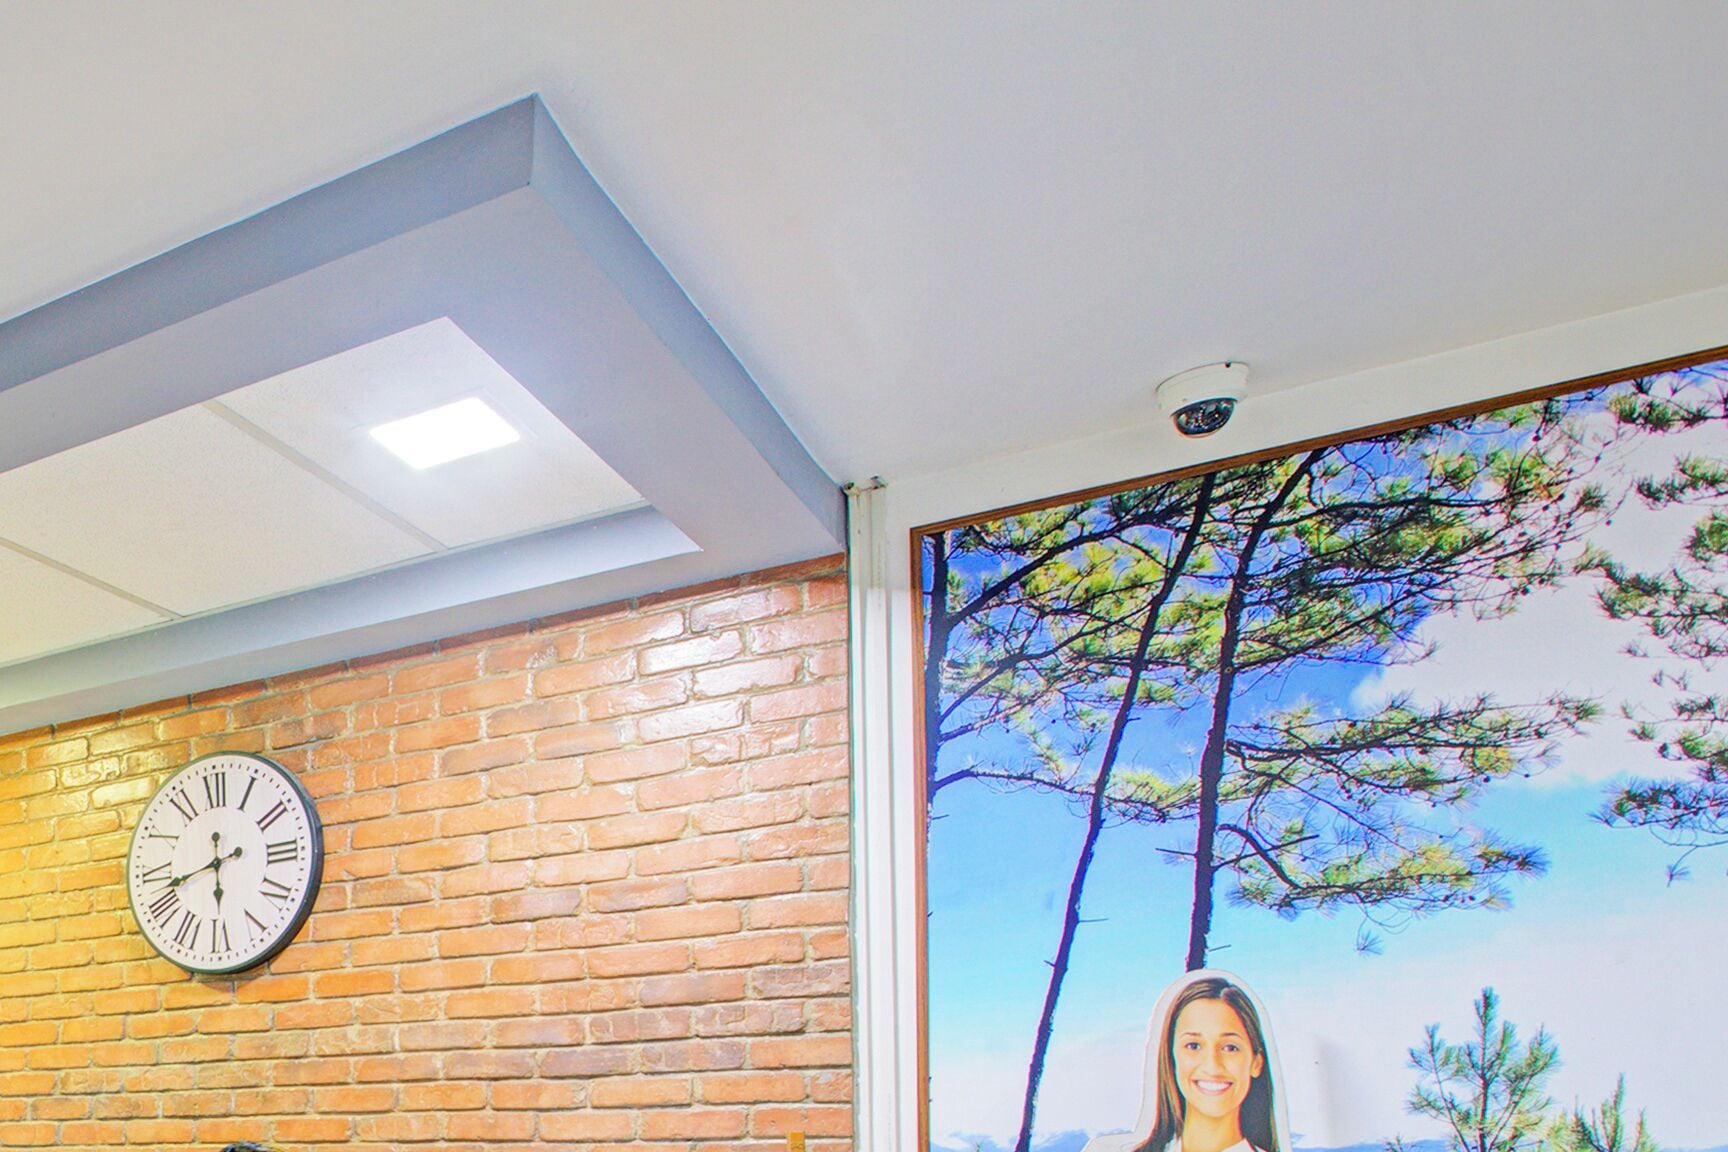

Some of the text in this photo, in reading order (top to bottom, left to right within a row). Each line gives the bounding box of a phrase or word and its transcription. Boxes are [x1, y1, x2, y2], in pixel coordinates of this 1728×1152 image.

[169, 788, 200, 828] XI
[202, 772, 227, 812] XII
[237, 776, 258, 812] I
[255, 799, 290, 832] II
[148, 825, 180, 850] X
[266, 838, 299, 865] III
[244, 908, 269, 942] V
